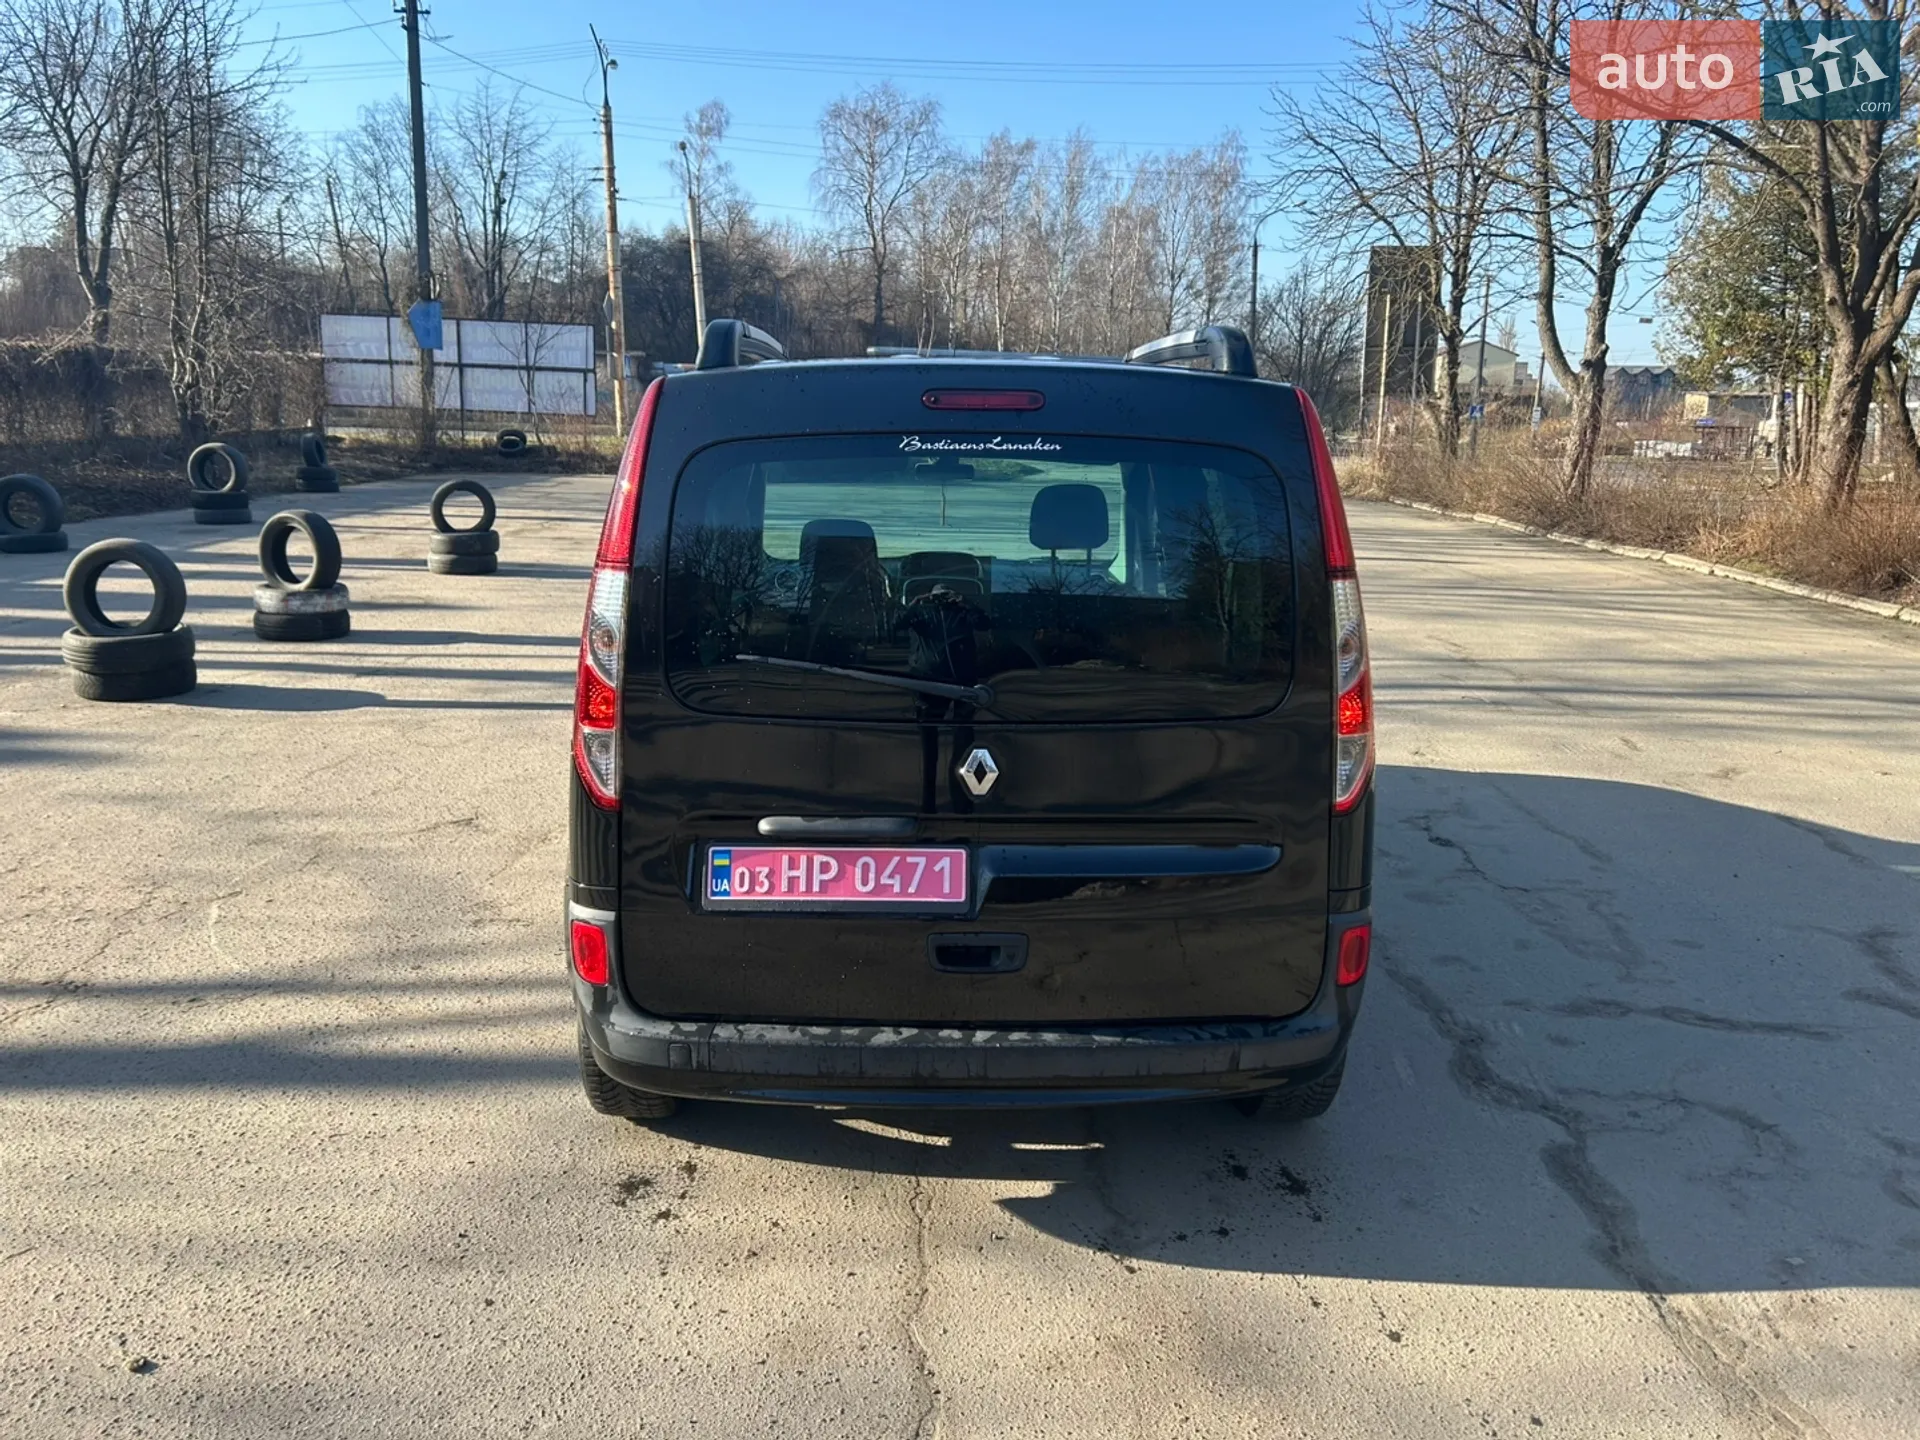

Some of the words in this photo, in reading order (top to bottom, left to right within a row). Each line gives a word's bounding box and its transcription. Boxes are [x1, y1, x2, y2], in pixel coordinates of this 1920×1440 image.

[712, 878, 730, 893] UA
[734, 866, 770, 893] 03
[781, 854, 839, 893] HP
[854, 855, 951, 894] 0471
